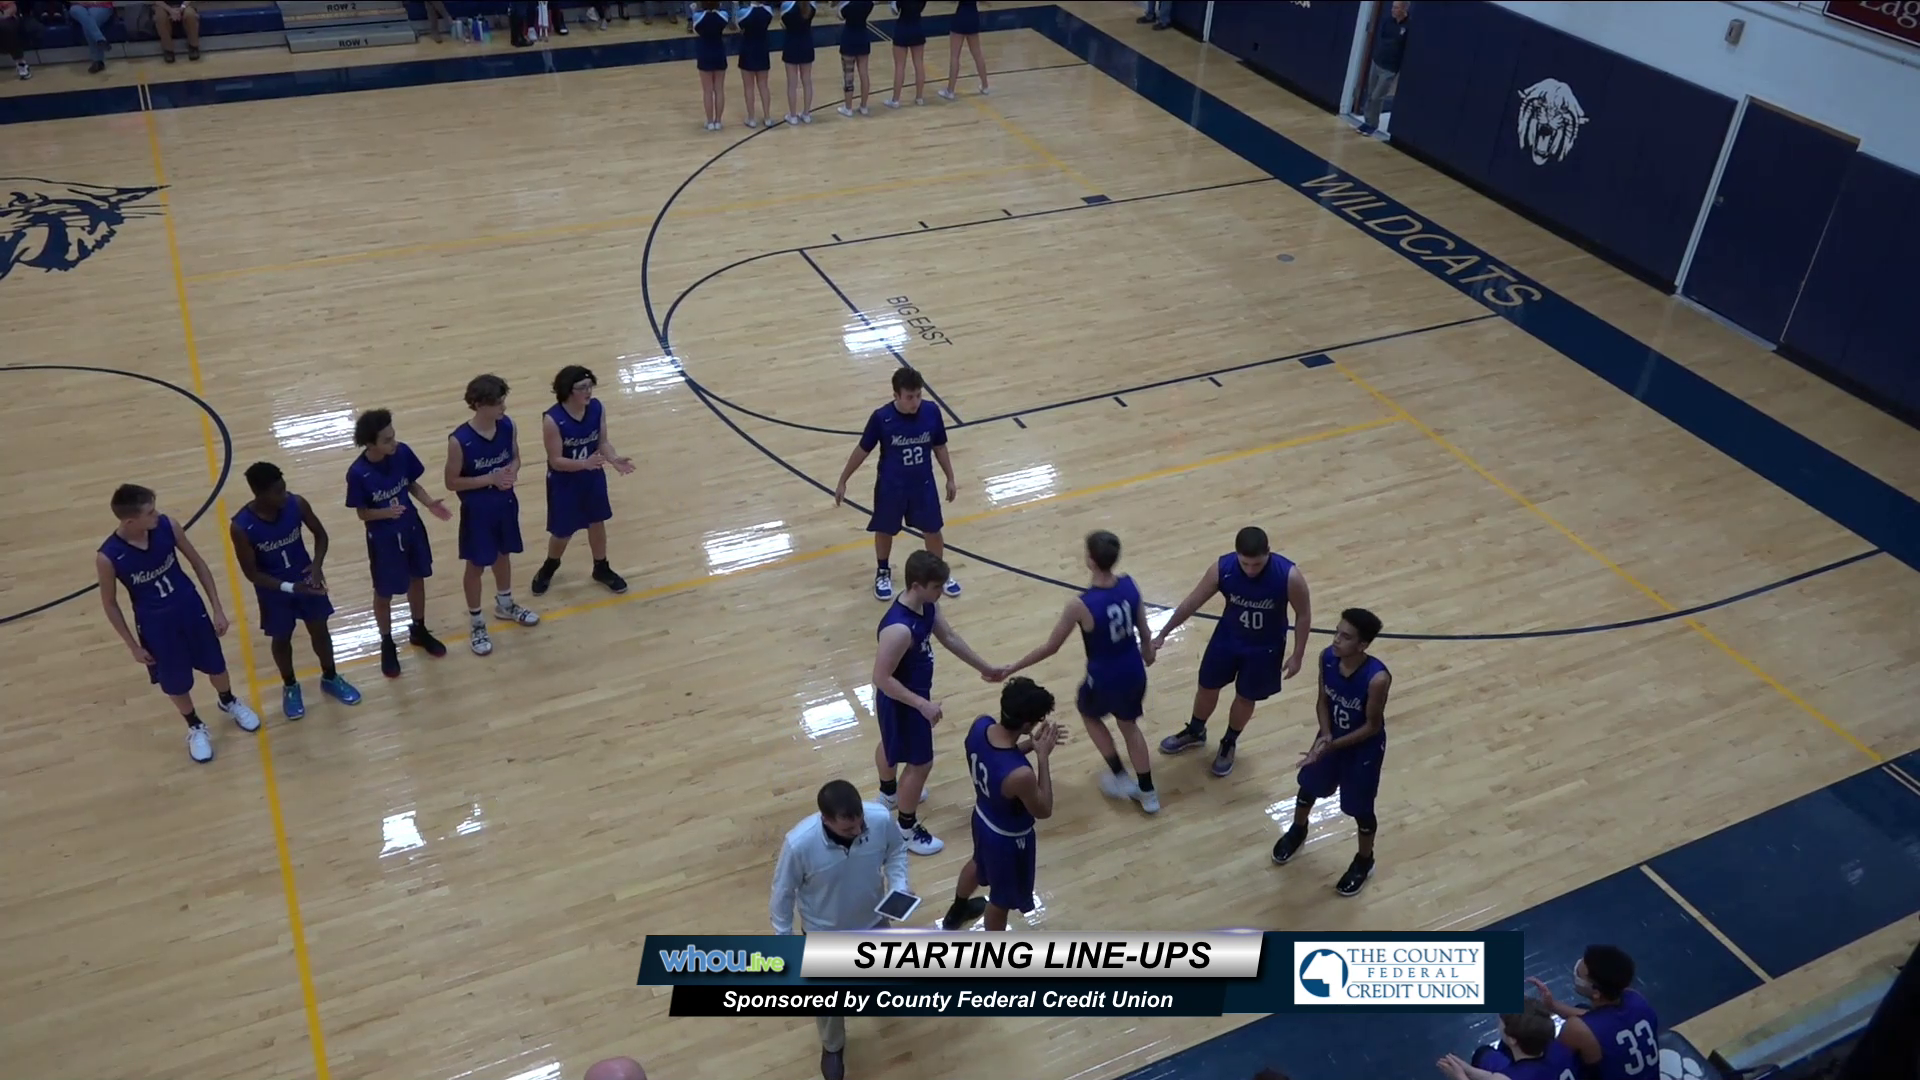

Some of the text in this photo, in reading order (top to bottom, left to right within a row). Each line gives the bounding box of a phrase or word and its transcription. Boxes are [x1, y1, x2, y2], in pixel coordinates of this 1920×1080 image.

[326, 3, 348, 12] ROW
[338, 39, 361, 47] ROW
[1301, 173, 1542, 307] WILDCATS
[886, 295, 954, 346] BIG EAST
[902, 446, 923, 466] 22
[281, 549, 291, 569] 1
[154, 575, 175, 598] 11
[1230, 593, 1275, 610] Waterville
[1106, 599, 1133, 644] 21
[1239, 610, 1264, 630] 40
[1333, 704, 1351, 730] 12
[1616, 1019, 1660, 1076] 33
